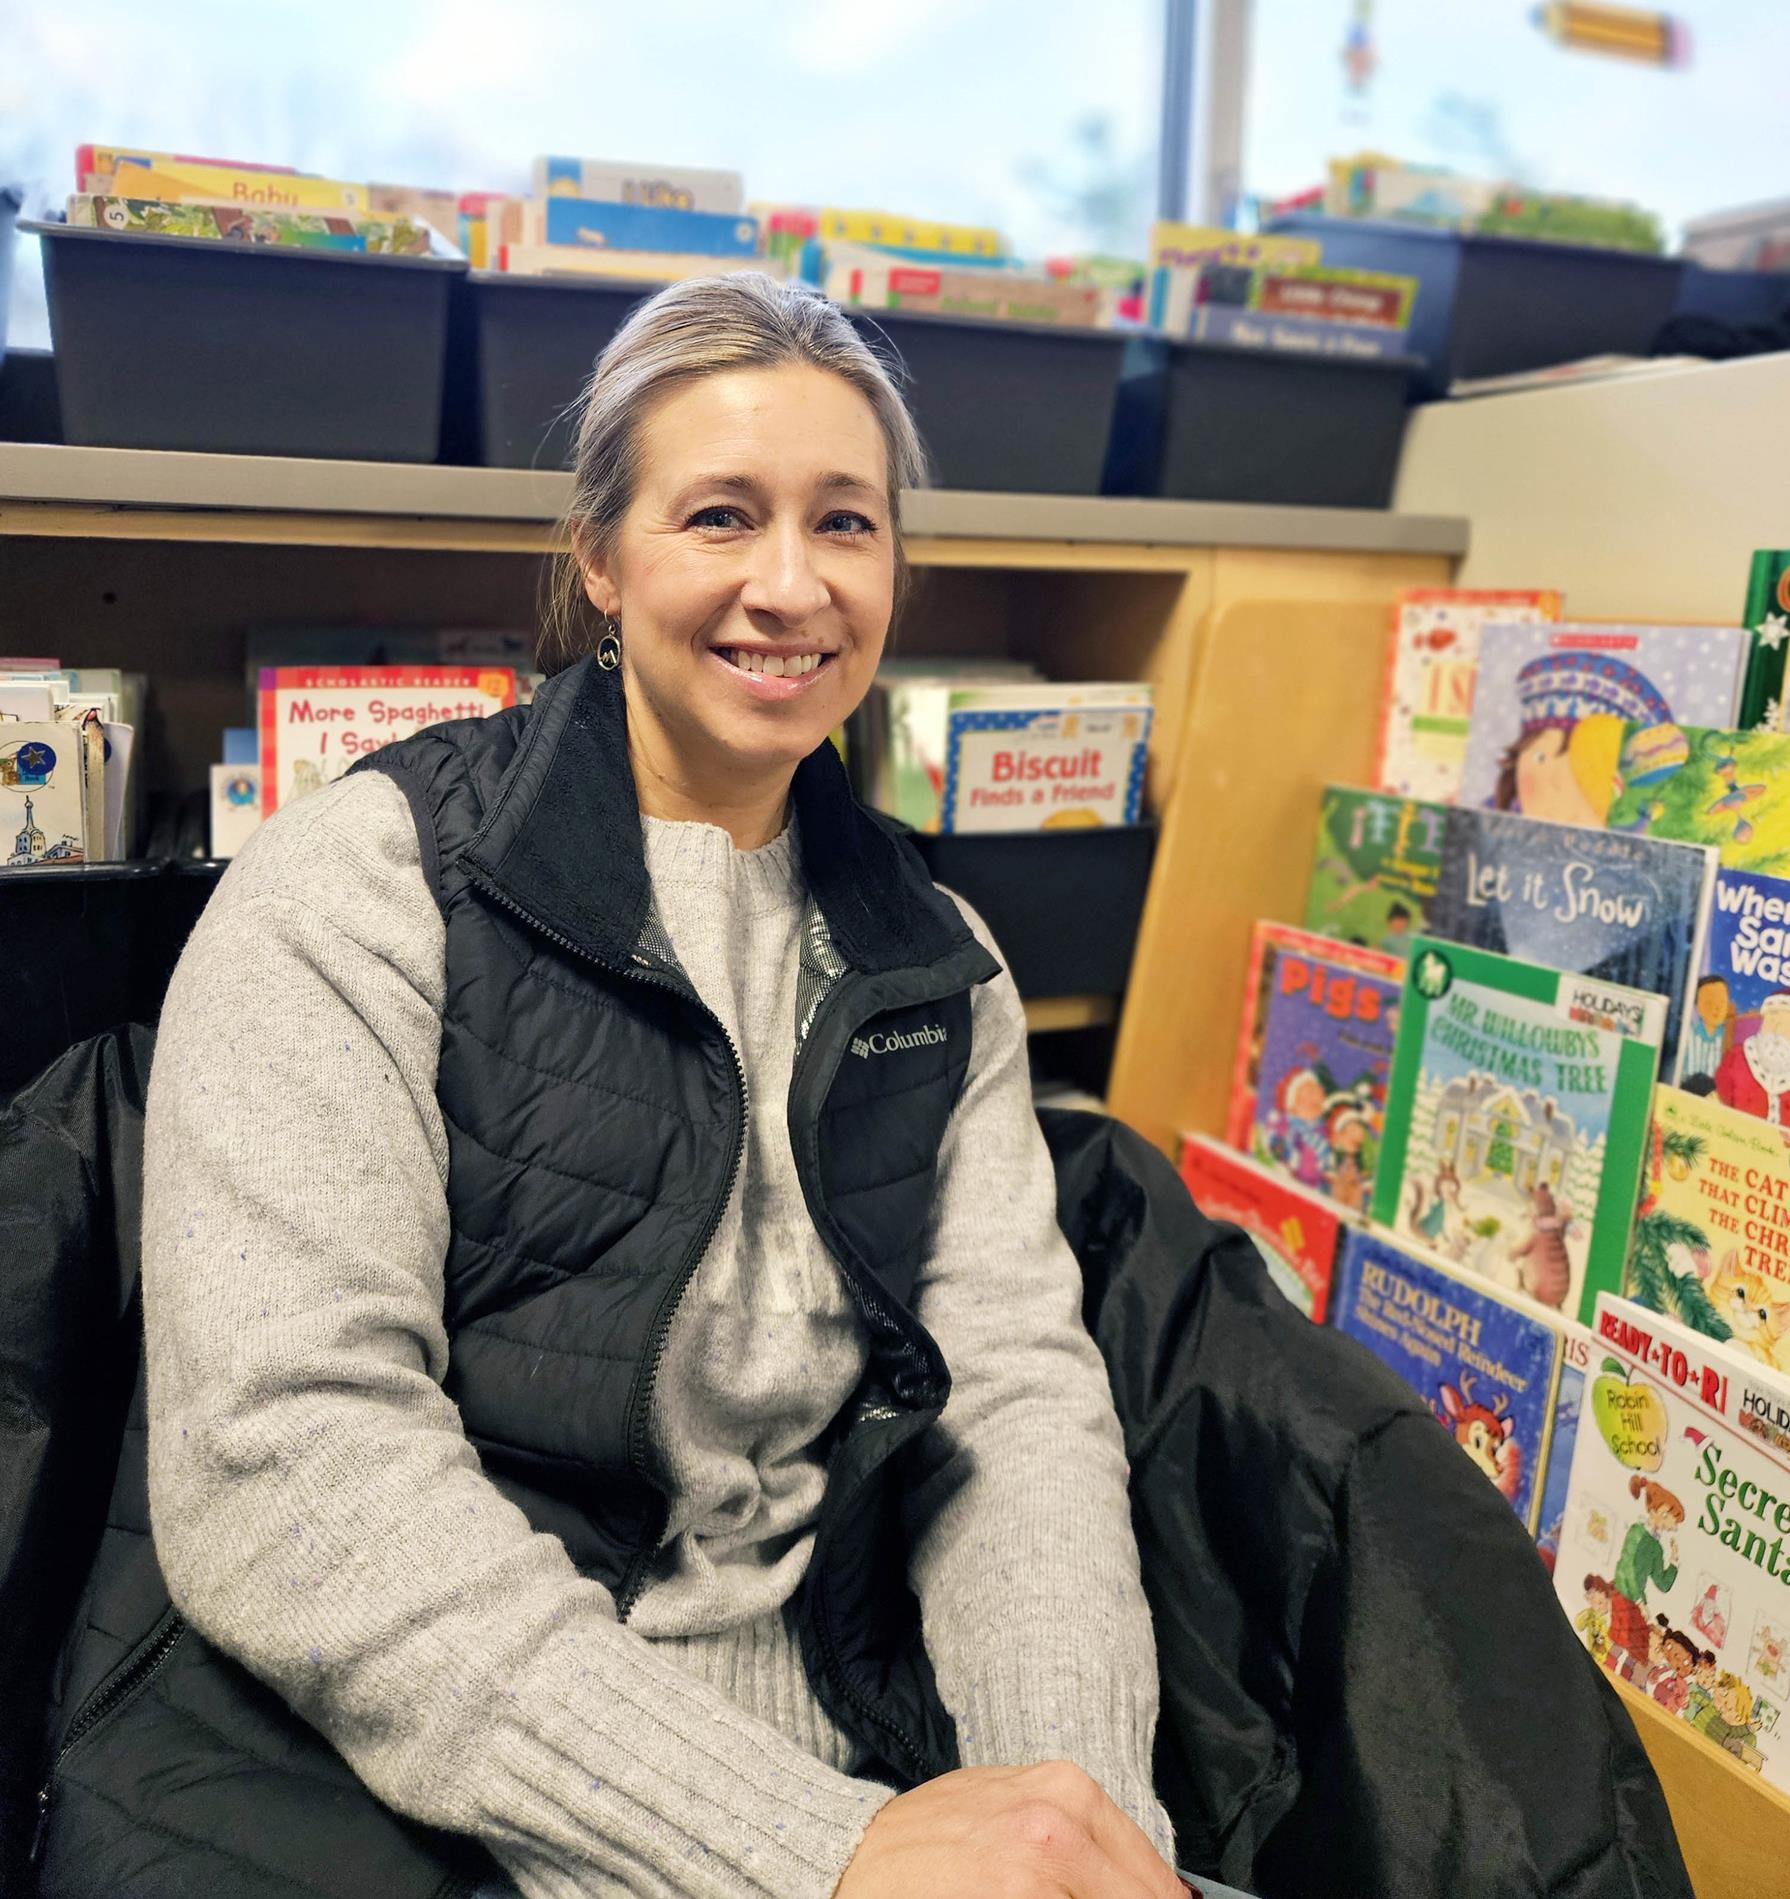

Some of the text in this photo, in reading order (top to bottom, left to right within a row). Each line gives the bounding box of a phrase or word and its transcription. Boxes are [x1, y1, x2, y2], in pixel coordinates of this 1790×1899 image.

[109, 211, 125, 222] 5
[305, 677, 471, 688] SCHOLASTIC READER
[289, 699, 485, 725] More Spaghetti
[319, 732, 328, 754] I
[991, 748, 1103, 782] Biscuit
[970, 781, 1117, 808] Finds a Friend
[1466, 852, 1513, 907] Let
[1522, 873, 1548, 910] it
[1553, 861, 1645, 928] Snow
[1281, 956, 1382, 1022] Pigs
[1431, 1014, 1543, 1088] CHRISTMAS
[1554, 1060, 1608, 1094] TREE
[1698, 1178, 1740, 1208] THAT
[1708, 1157, 1790, 1202] THE CAT
[1708, 1208, 1740, 1235] THE
[1362, 1259, 1483, 1347] RUDOLPH
[1458, 1340, 1528, 1393] Reindeer
[1606, 1389, 1649, 1410] Robin
[1620, 1412, 1644, 1433] Hill
[1610, 1433, 1661, 1457] School
